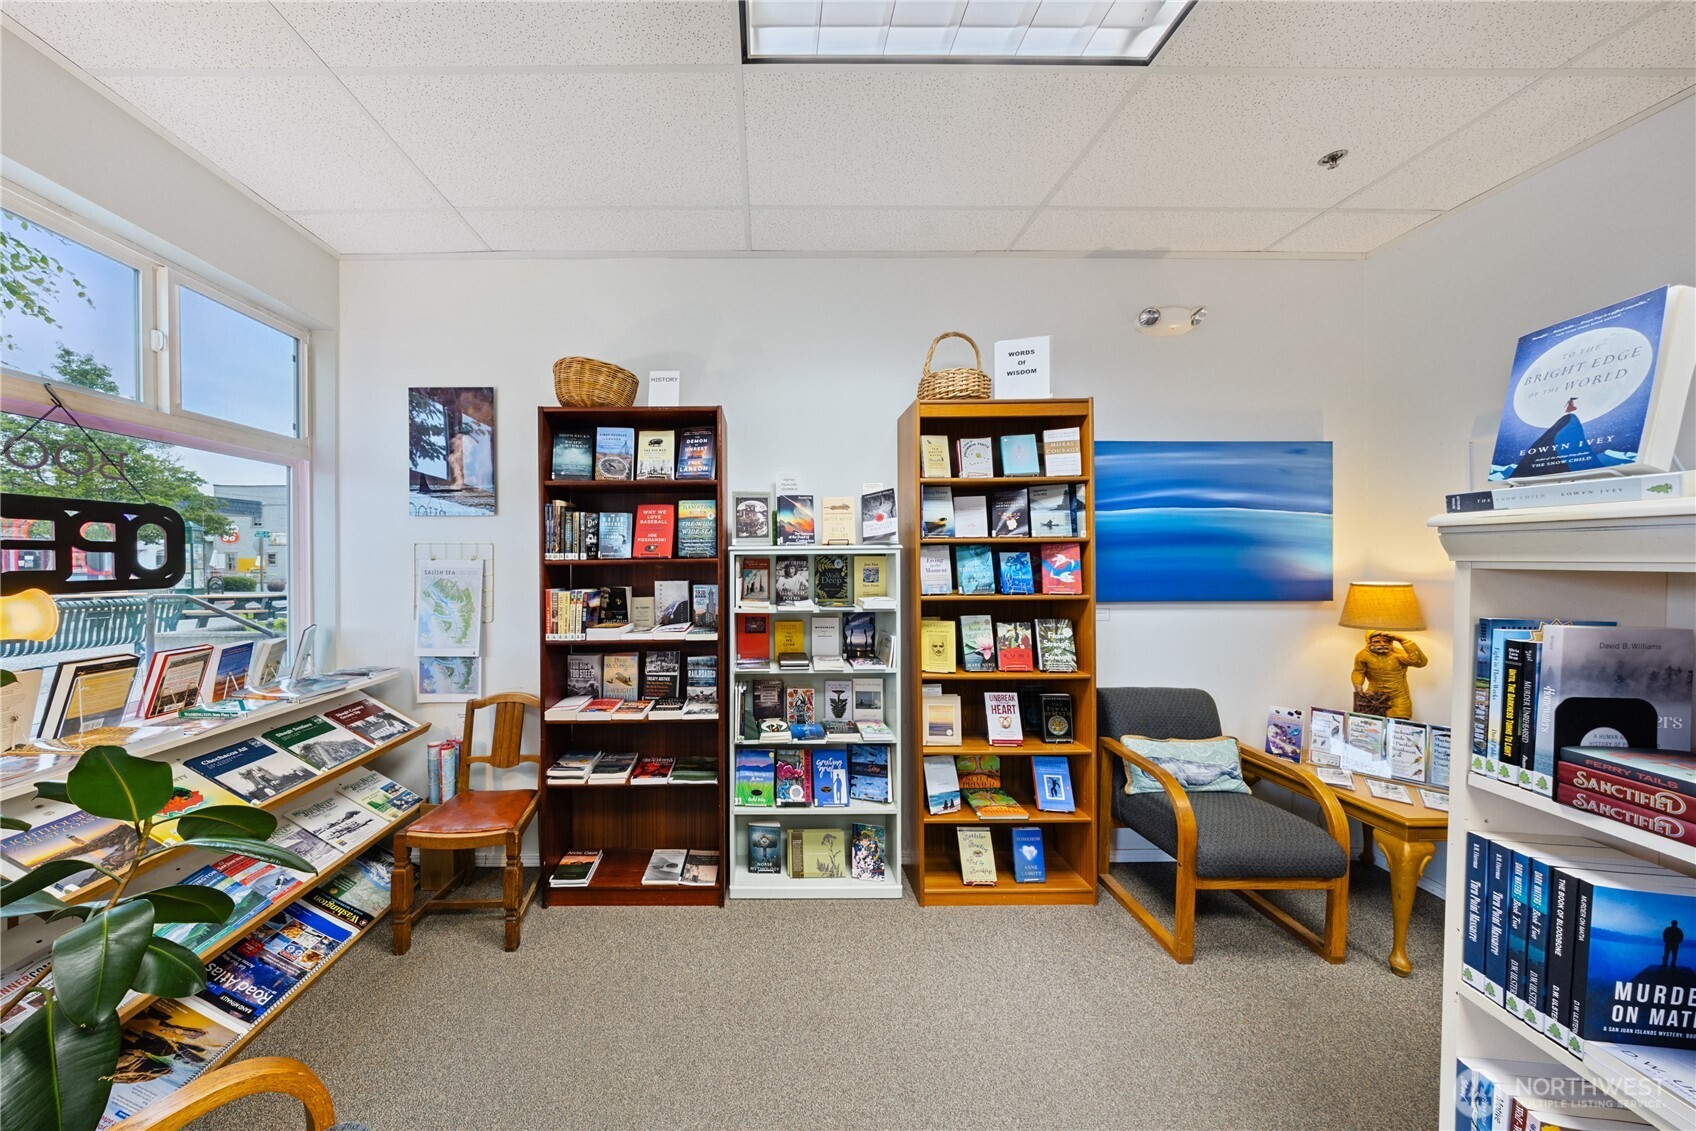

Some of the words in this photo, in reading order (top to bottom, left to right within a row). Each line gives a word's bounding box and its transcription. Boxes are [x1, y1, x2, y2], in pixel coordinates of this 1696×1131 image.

[1008, 349, 1035, 357] WORDS
[1562, 351, 1576, 360] TO
[1580, 343, 1602, 356] THE
[1524, 361, 1586, 386] BRIGHT
[1592, 346, 1642, 368] EDGE
[1528, 390, 1539, 398] OF
[1542, 386, 1560, 396] THE
[1564, 368, 1628, 392] WORLD
[1519, 442, 1571, 456] EOWYN
[1578, 435, 1616, 448] IVEY
[1568, 456, 1592, 464] CHILD
[821, 576, 842, 586] Deep
[570, 670, 579, 678] TOO
[580, 670, 594, 678] STEEP
[1476, 690, 1485, 701] TO
[991, 705, 1016, 714] HEART
[1475, 703, 1485, 721] PAY
[1541, 686, 1555, 733] Homewaters
[276, 729, 292, 738] Skagit
[293, 722, 312, 731] Settlers
[201, 750, 238, 766] Chechacos
[816, 758, 842, 769] greeting
[819, 766, 833, 778] grief
[1585, 759, 1632, 776] FERRY
[1637, 773, 1678, 790] TAILS
[1573, 771, 1687, 815] SANCTIFIED
[1573, 793, 1684, 838] SANCTIFIED
[24, 831, 60, 846] WEST
[1470, 879, 1481, 893] Turn
[1535, 870, 1543, 885] DARK
[1470, 892, 1480, 909] Point
[1493, 891, 1503, 905] Turn
[1512, 898, 1521, 915] Book
[314, 894, 360, 923] Washington
[1491, 905, 1502, 921] Point
[1532, 908, 1541, 926] Book
[1557, 908, 1564, 917] OF
[1469, 909, 1480, 942] Massacre
[1531, 926, 1539, 940] Two
[1490, 921, 1502, 956] Massacre
[1555, 918, 1564, 956] BLOODBONE
[206, 963, 241, 988] Atlas
[232, 980, 273, 1006] Road
[1611, 1004, 1637, 1023] ON
